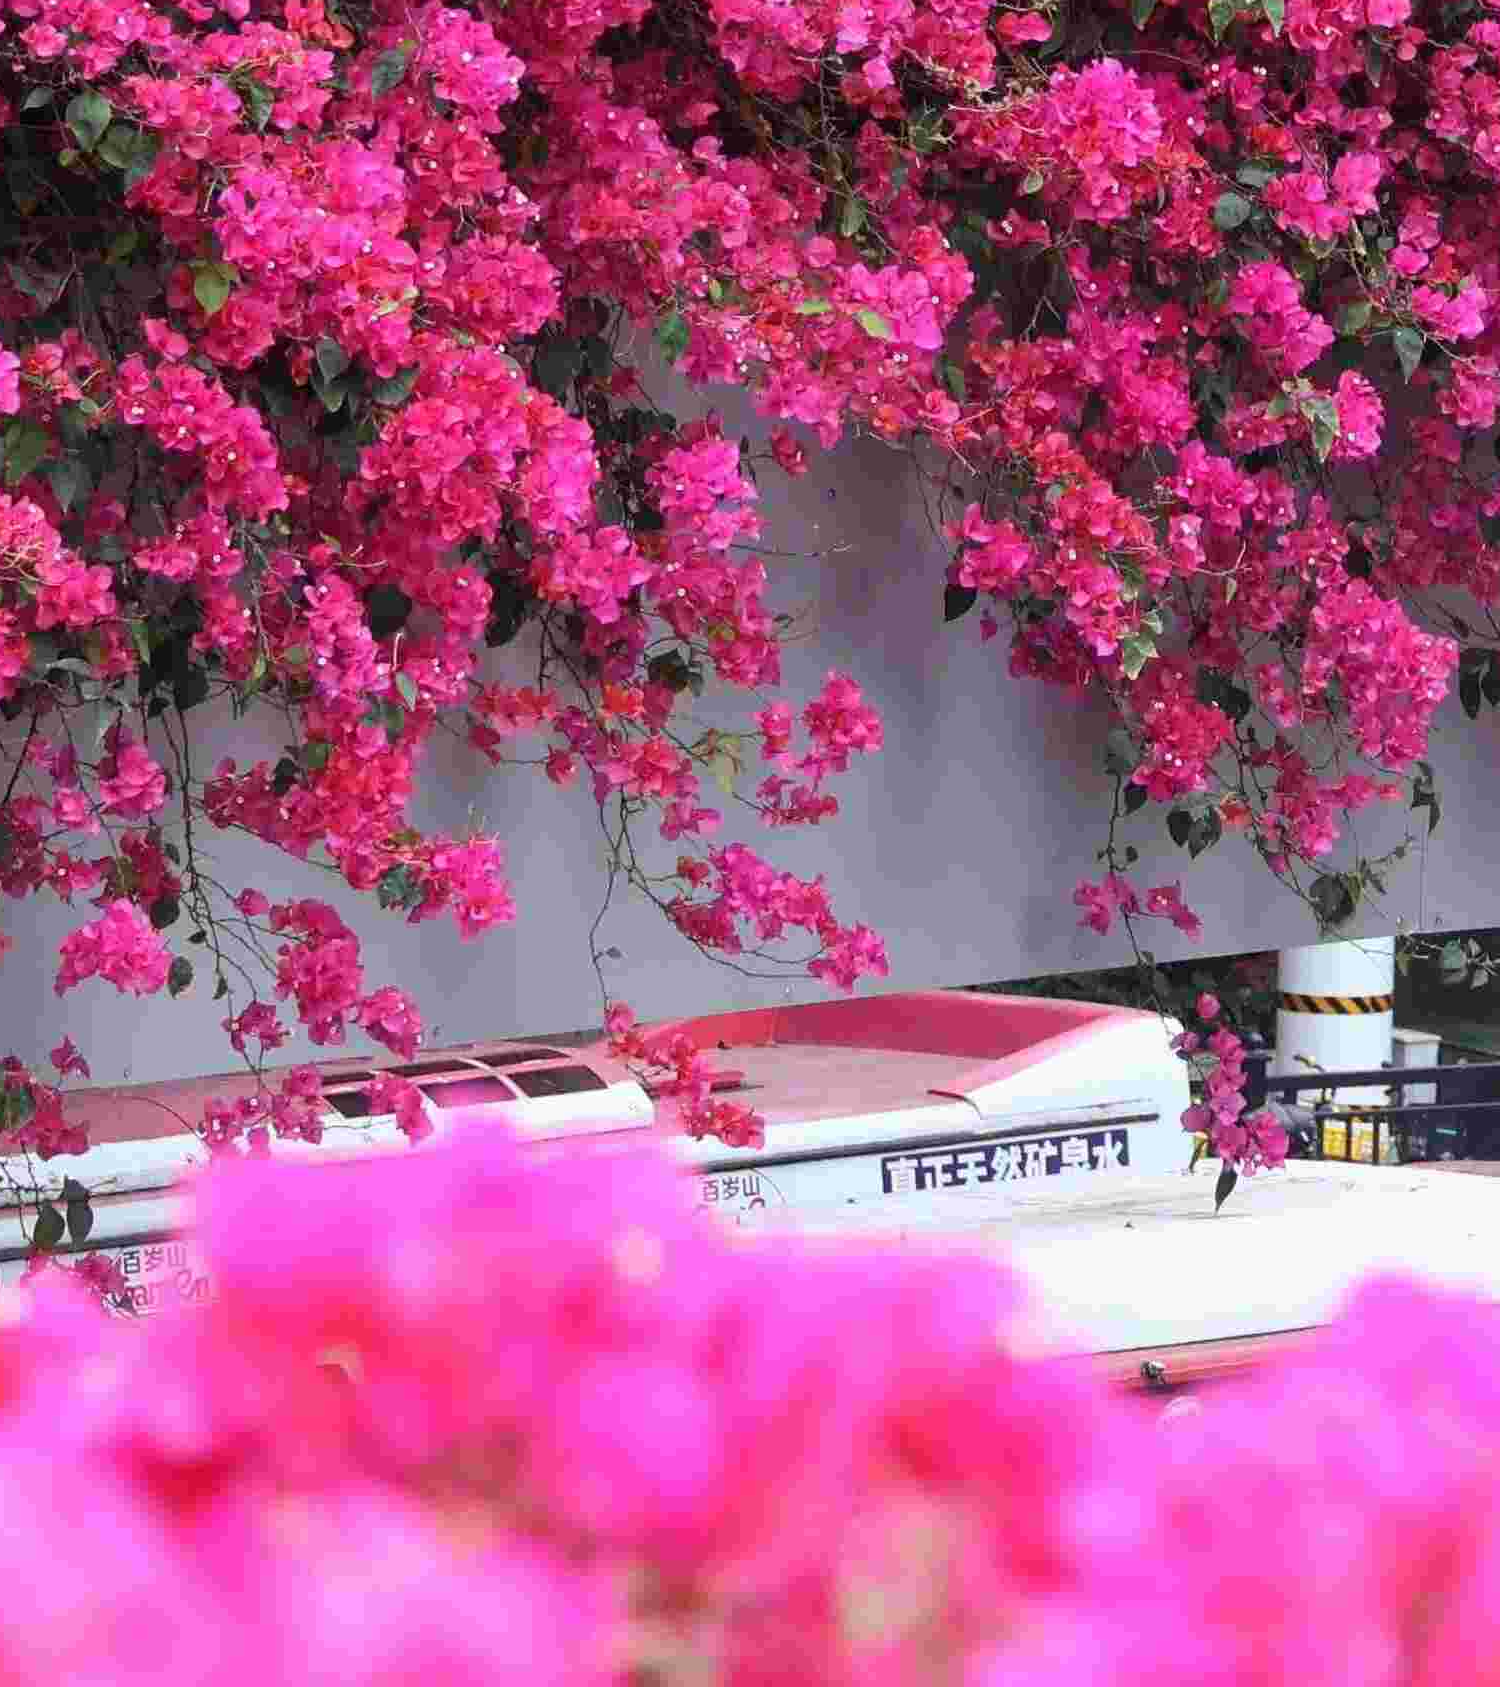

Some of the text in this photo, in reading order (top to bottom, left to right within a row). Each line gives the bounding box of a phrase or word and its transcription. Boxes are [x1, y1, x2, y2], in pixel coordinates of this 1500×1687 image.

[700, 1175, 761, 1202] 百岁山
[123, 1245, 188, 1274] 百岁山
